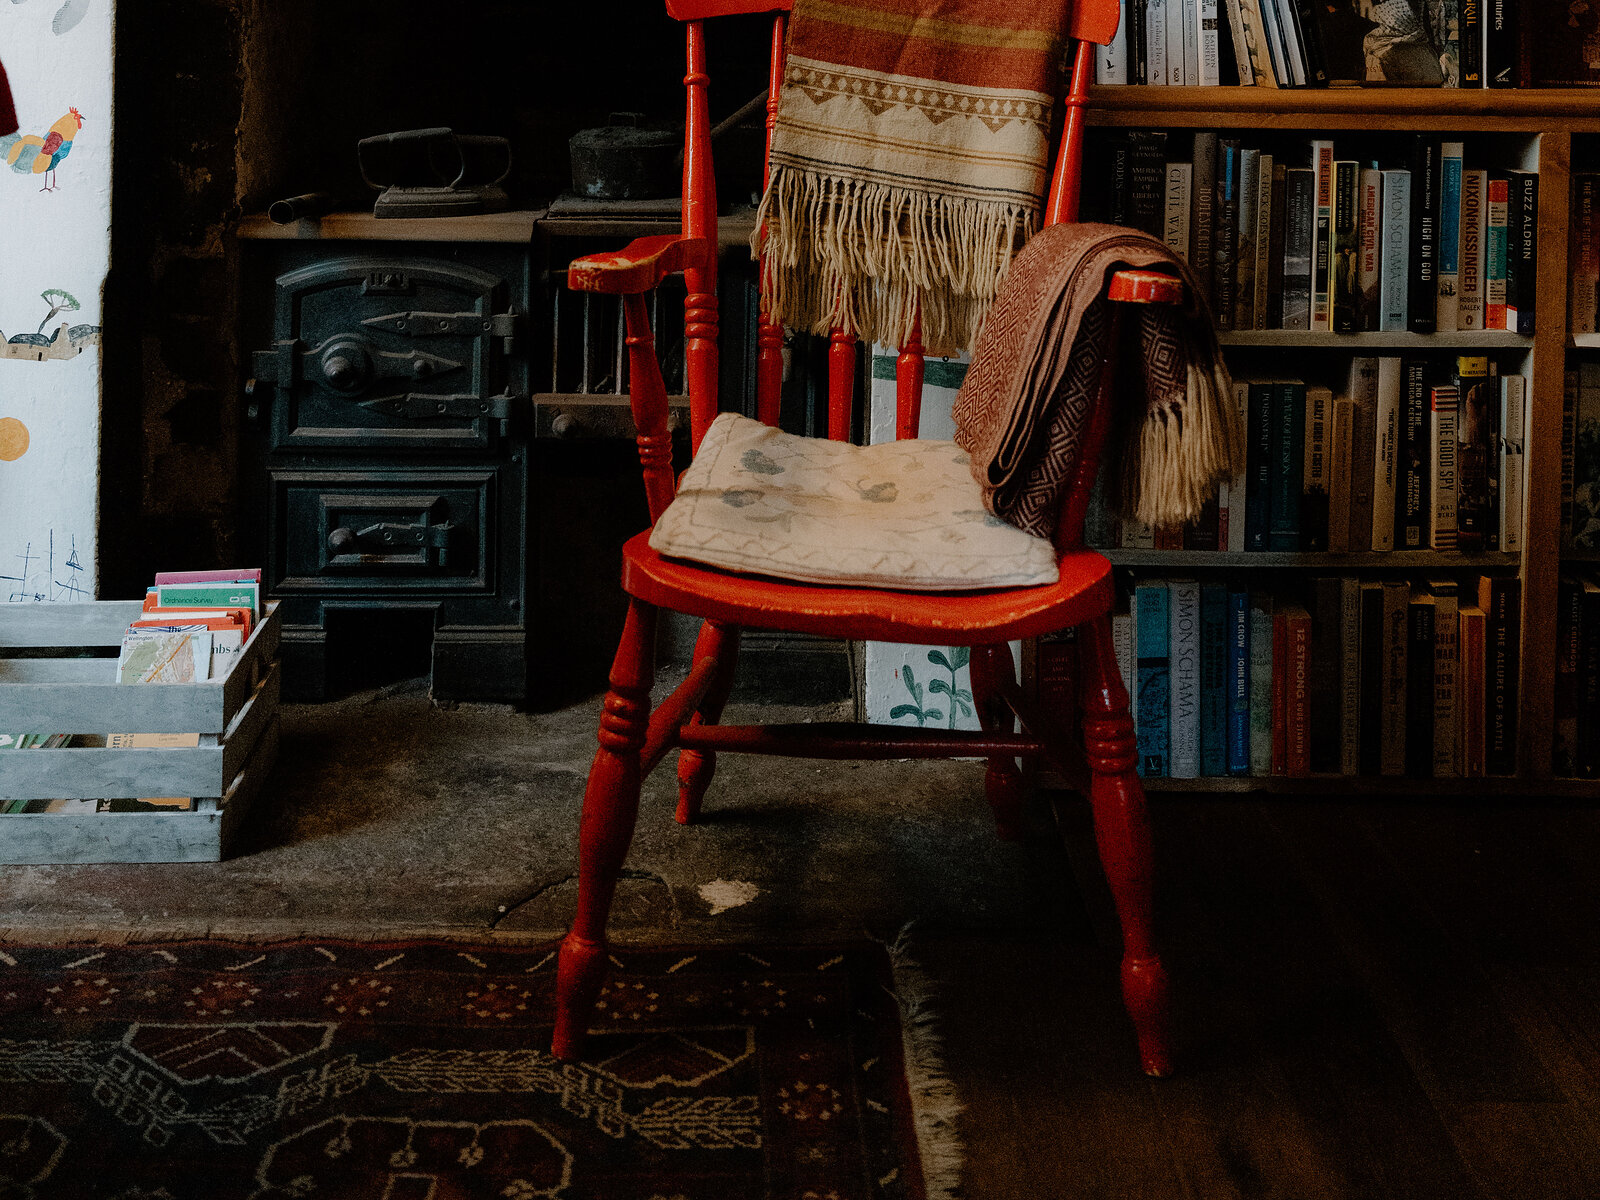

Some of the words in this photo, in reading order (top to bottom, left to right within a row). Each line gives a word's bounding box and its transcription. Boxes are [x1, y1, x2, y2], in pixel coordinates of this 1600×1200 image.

[1169, 168, 1181, 211] CIVIL
[1390, 178, 1405, 226] SIMON
[1466, 174, 1480, 218] NIXON
[1524, 179, 1533, 211] BUZZ
[1366, 185, 1375, 227] AMERICAN
[1167, 216, 1179, 246] WAR
[1197, 187, 1212, 270] HOMESICKNESS
[1365, 229, 1374, 251] CIVIL
[1422, 217, 1432, 240] HIGH
[1523, 215, 1532, 259] ALDRIN
[1365, 253, 1374, 272] WAR
[1389, 226, 1404, 281] SCHAMA
[1421, 245, 1431, 257] ON
[1464, 222, 1479, 292] KISSINGER
[1421, 262, 1431, 281] GOD
[1408, 366, 1416, 406] AMERICAN
[1415, 400, 1422, 410] OF
[1407, 407, 1415, 441] CENTURY
[1440, 416, 1454, 436] THE
[1440, 439, 1454, 468] GOOD
[1440, 470, 1454, 490] SPY
[193, 597, 214, 605] Survey
[1178, 588, 1194, 643] SIMON
[1237, 610, 1245, 623] JIM
[1237, 624, 1245, 648] CROW
[1296, 628, 1305, 642] 12
[1497, 627, 1505, 646] THE
[1237, 657, 1245, 678] JOHN
[1296, 644, 1305, 700] STRONG
[1496, 651, 1505, 691] ALLURE
[1178, 648, 1194, 719] SCHAMA
[1237, 679, 1245, 698] BULL
[1496, 695, 1504, 710] OF
